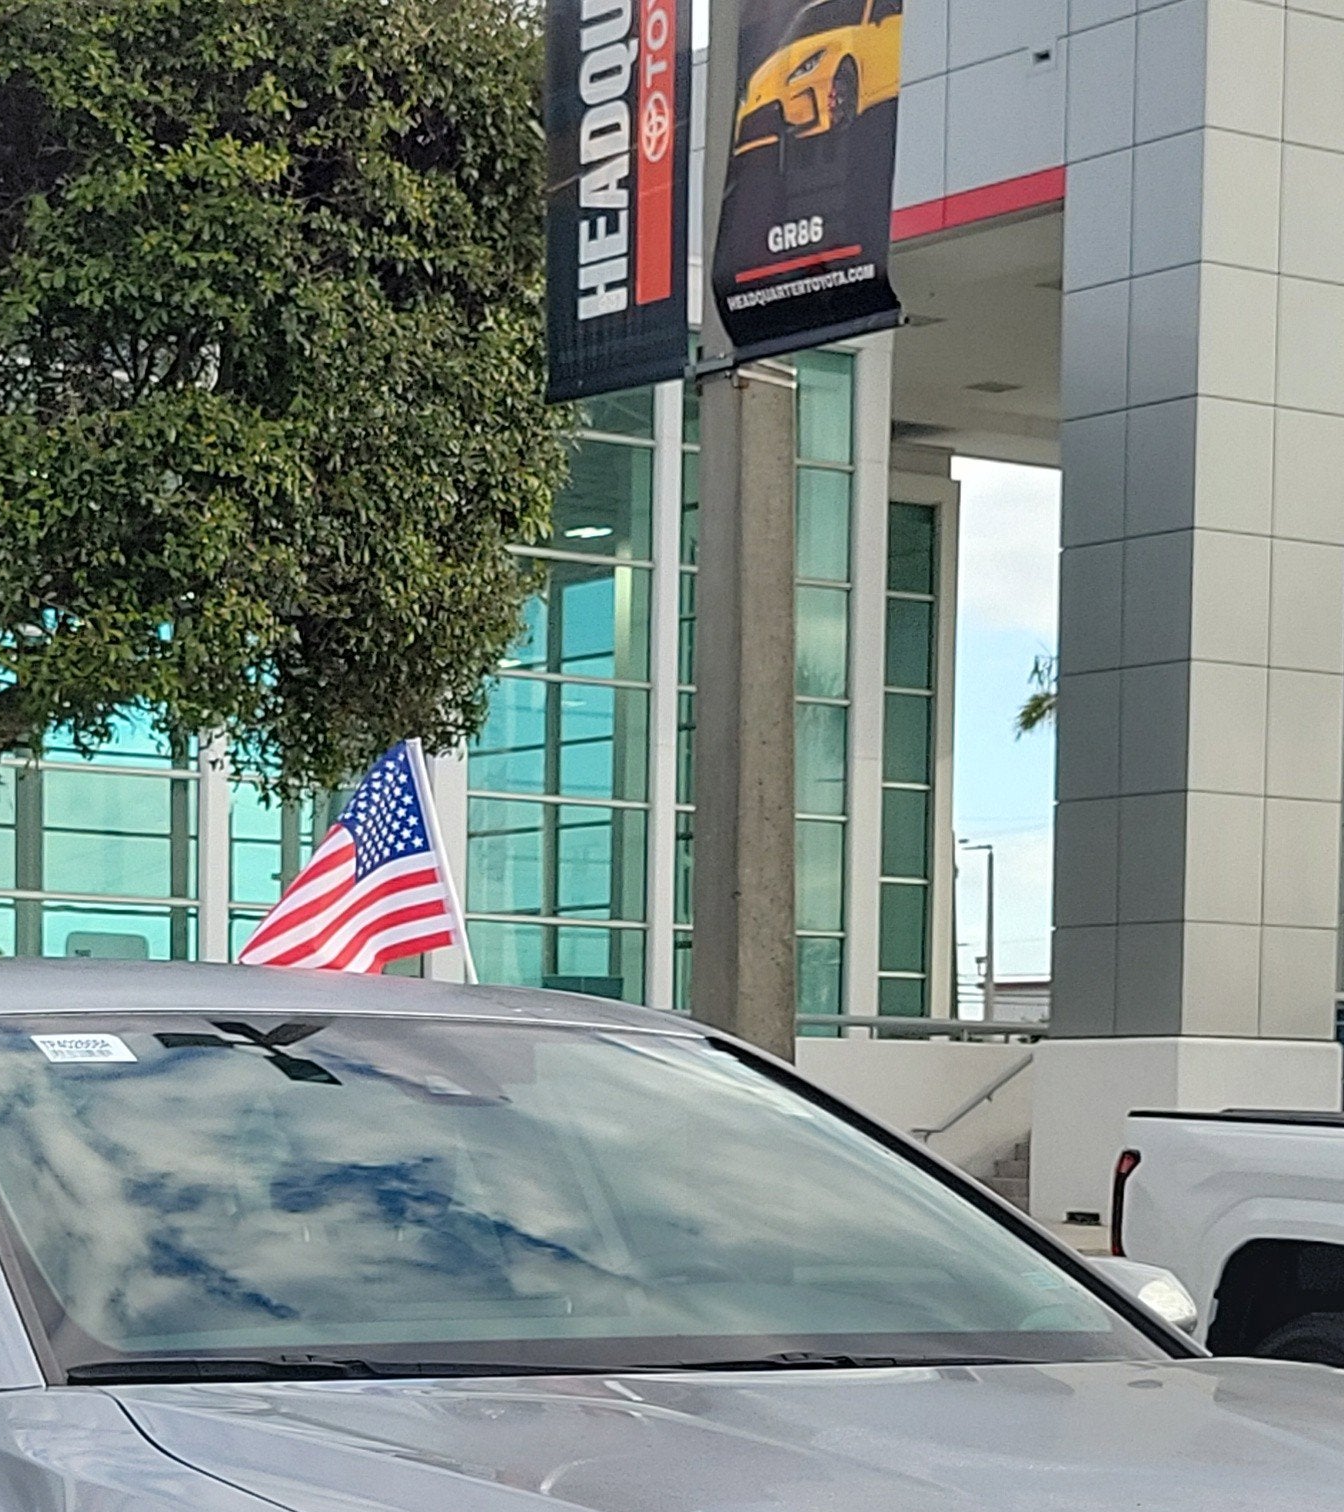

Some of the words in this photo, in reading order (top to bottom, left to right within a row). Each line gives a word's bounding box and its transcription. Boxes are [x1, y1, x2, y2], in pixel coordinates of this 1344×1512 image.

[645, 0, 670, 88] TO
[577, 0, 640, 321] HEADQU
[768, 215, 824, 254] GR86
